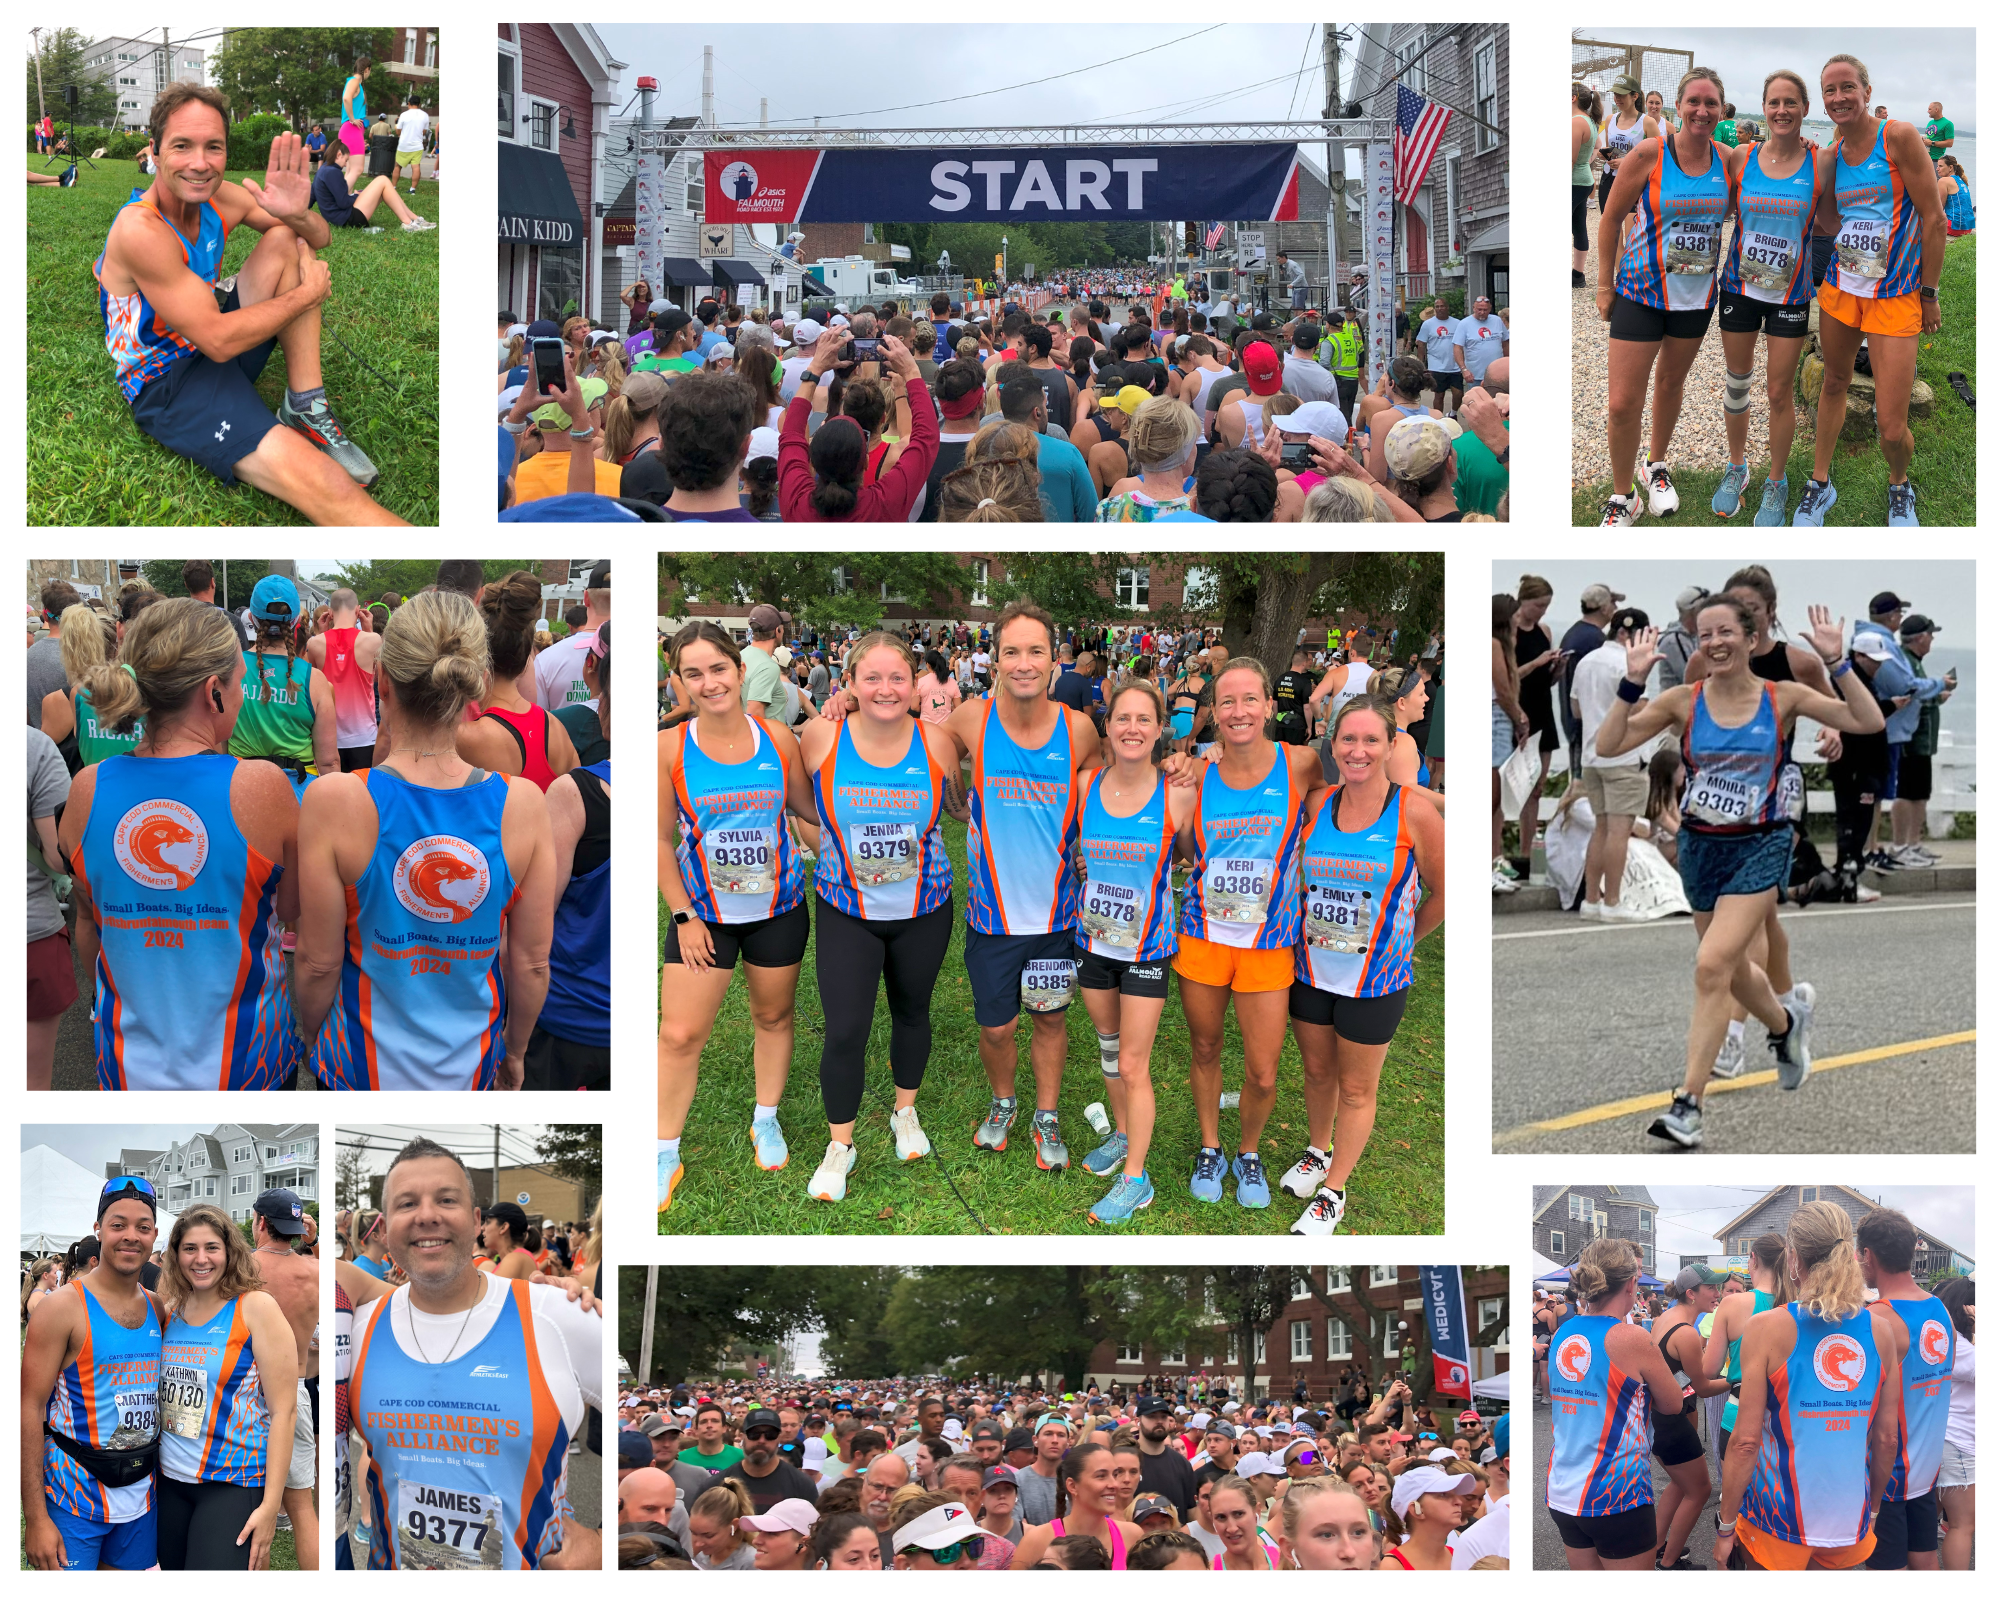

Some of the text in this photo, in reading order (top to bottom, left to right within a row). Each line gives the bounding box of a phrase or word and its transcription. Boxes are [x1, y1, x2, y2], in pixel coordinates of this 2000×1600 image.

[1610, 142, 1628, 150] 9100
[929, 158, 1158, 213] START
[738, 199, 785, 207] FALMOUTH
[1665, 198, 1729, 208] FISHERMEN'S
[1674, 206, 1723, 216] ALLIANCE
[1742, 196, 1808, 210] FISHERMEN'S
[1748, 205, 1800, 217] ALLIANCE
[498, 216, 573, 242] AIN KIDD
[606, 224, 637, 233] CAPTAIN
[1683, 223, 1711, 233] EMILY
[1852, 221, 1873, 231] KERI
[1241, 234, 1261, 242] STOP
[1675, 235, 1713, 251] 9381
[1754, 233, 1788, 249] BRIGID
[1841, 233, 1881, 252] 9386
[704, 247, 729, 255] WHARF
[1746, 246, 1789, 268] 9378
[571, 680, 585, 691] THE
[242, 684, 298, 706] AJARDO
[1023, 772, 1059, 780] COMMERCIAL
[838, 787, 929, 800] FISHERMEN'S
[986, 777, 1067, 794] FISHERMEN'S
[1707, 776, 1746, 796] MOIRA
[694, 790, 782, 807] FISHERMEN'S
[849, 798, 920, 809] ALLIANCE
[997, 789, 1057, 804] ALLIANCE
[1697, 791, 1747, 817] 9383
[709, 800, 774, 815] ALLIANCE
[117, 801, 195, 845] CAPE COD COMMERCIAL
[863, 823, 903, 837] JENNA
[1206, 816, 1282, 831] FISHERMEN'S
[718, 830, 763, 844] SYLVIA
[189, 832, 205, 873] ALLIANCE
[859, 839, 911, 860] 9379
[1082, 839, 1157, 853] FISHERMEN'S
[396, 837, 478, 878] CAPE COD COMMERCIAL
[715, 846, 768, 866] 9380
[1089, 850, 1146, 862] ALLIANCE
[1336, 852, 1377, 860] COMMERCIAL
[121, 857, 174, 886] FISHERMEN'S
[1226, 860, 1254, 872] KERI
[1304, 857, 1387, 873] FISHERMEN'S
[1311, 868, 1373, 882] ALLIANCE
[468, 868, 487, 908] ALLIANCE
[1097, 883, 1134, 900] BRIGID
[1213, 875, 1264, 895] 9386
[1322, 887, 1355, 903] EMILY
[103, 902, 229, 916] Small Boats. Big Ideas.
[399, 889, 449, 919] FISHERMEN'S
[1089, 897, 1135, 922] 9378
[1313, 902, 1359, 926] 9381
[103, 916, 229, 931] #fishrunfalmouth team
[143, 930, 185, 949] 2024
[374, 929, 467, 947] Small Boats. Big
[371, 941, 496, 960] #fishrunfalmouth team
[410, 957, 451, 977] 2024
[1025, 960, 1074, 971] BRENDON
[1027, 974, 1071, 991] 9385
[1828, 1335, 1858, 1348] COMMERCIAL
[165, 1366, 198, 1382] KATHRYN
[1855, 1354, 1865, 1379] ALLIANCE
[1816, 1370, 1846, 1389] FISHERMEN'S
[1574, 1388, 1584, 1397] Big
[379, 1399, 403, 1407] CAPE
[427, 1400, 501, 1412] COMMERCIAL
[1469, 1404, 1497, 1412] ceiving
[1562, 1404, 1577, 1415] 2024
[1800, 1400, 1821, 1408] Small
[1845, 1400, 1858, 1408] Big
[124, 1410, 156, 1431] 9384
[1798, 1409, 1859, 1419] #fishrunfalmouth
[367, 1412, 520, 1437] FISHERMEN'S
[1825, 1419, 1851, 1432] 2024
[386, 1432, 500, 1456] ALLIANCE
[398, 1453, 487, 1468] Small Boats. Big Ideas.
[415, 1487, 481, 1515] JAMES
[408, 1510, 489, 1551] 9377
